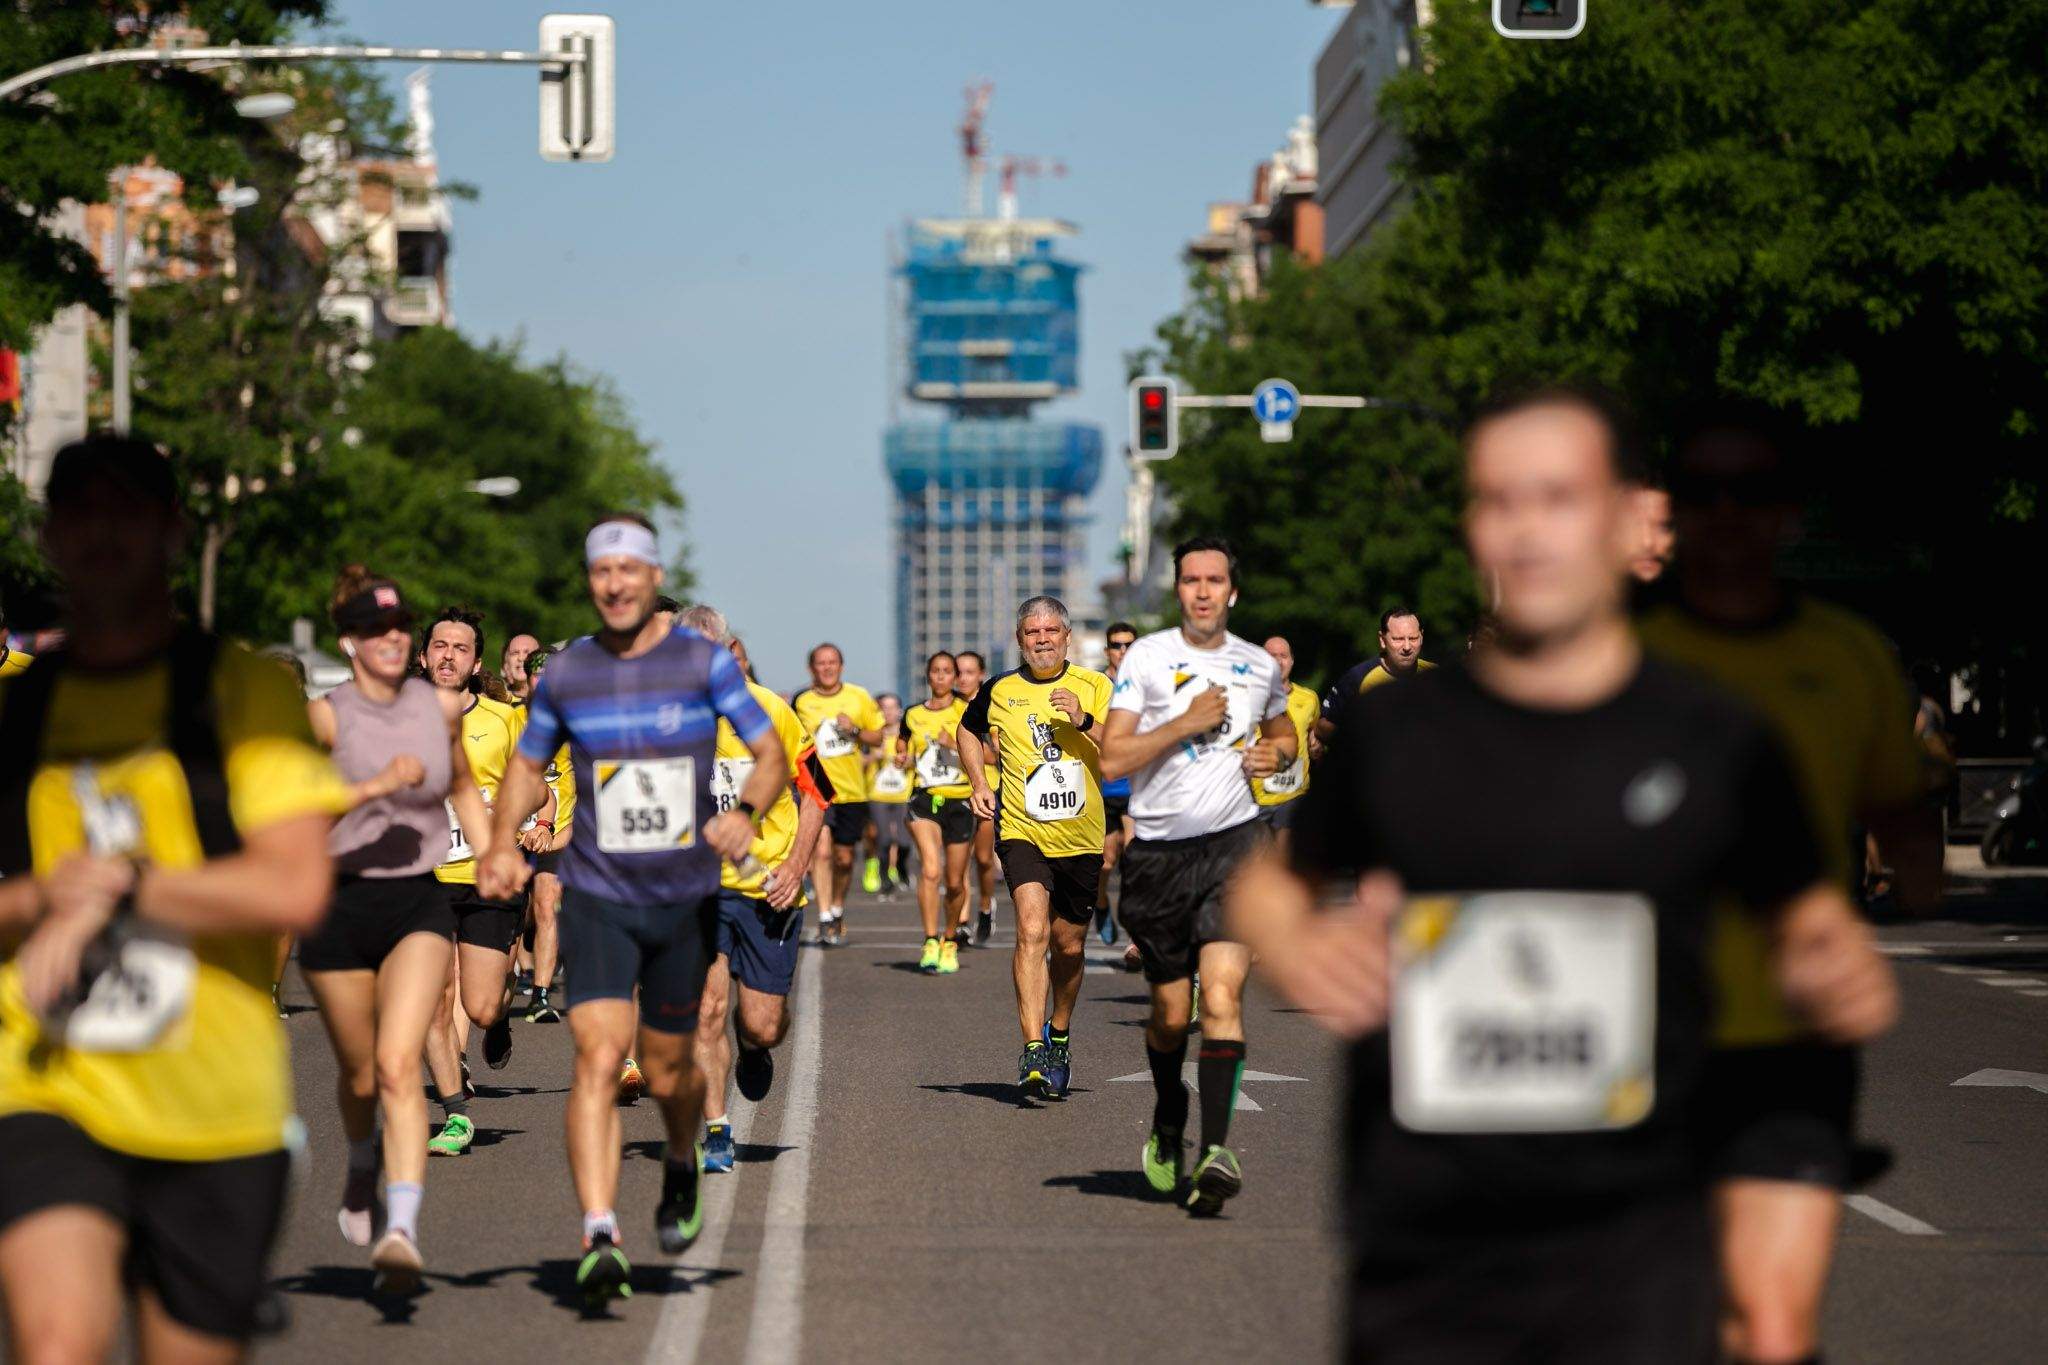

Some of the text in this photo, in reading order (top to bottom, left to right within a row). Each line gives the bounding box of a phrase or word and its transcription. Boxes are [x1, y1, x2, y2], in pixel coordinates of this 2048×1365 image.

[1045, 747, 1059, 759] 13
[1039, 790, 1077, 810] 4910
[622, 806, 668, 834] 553
